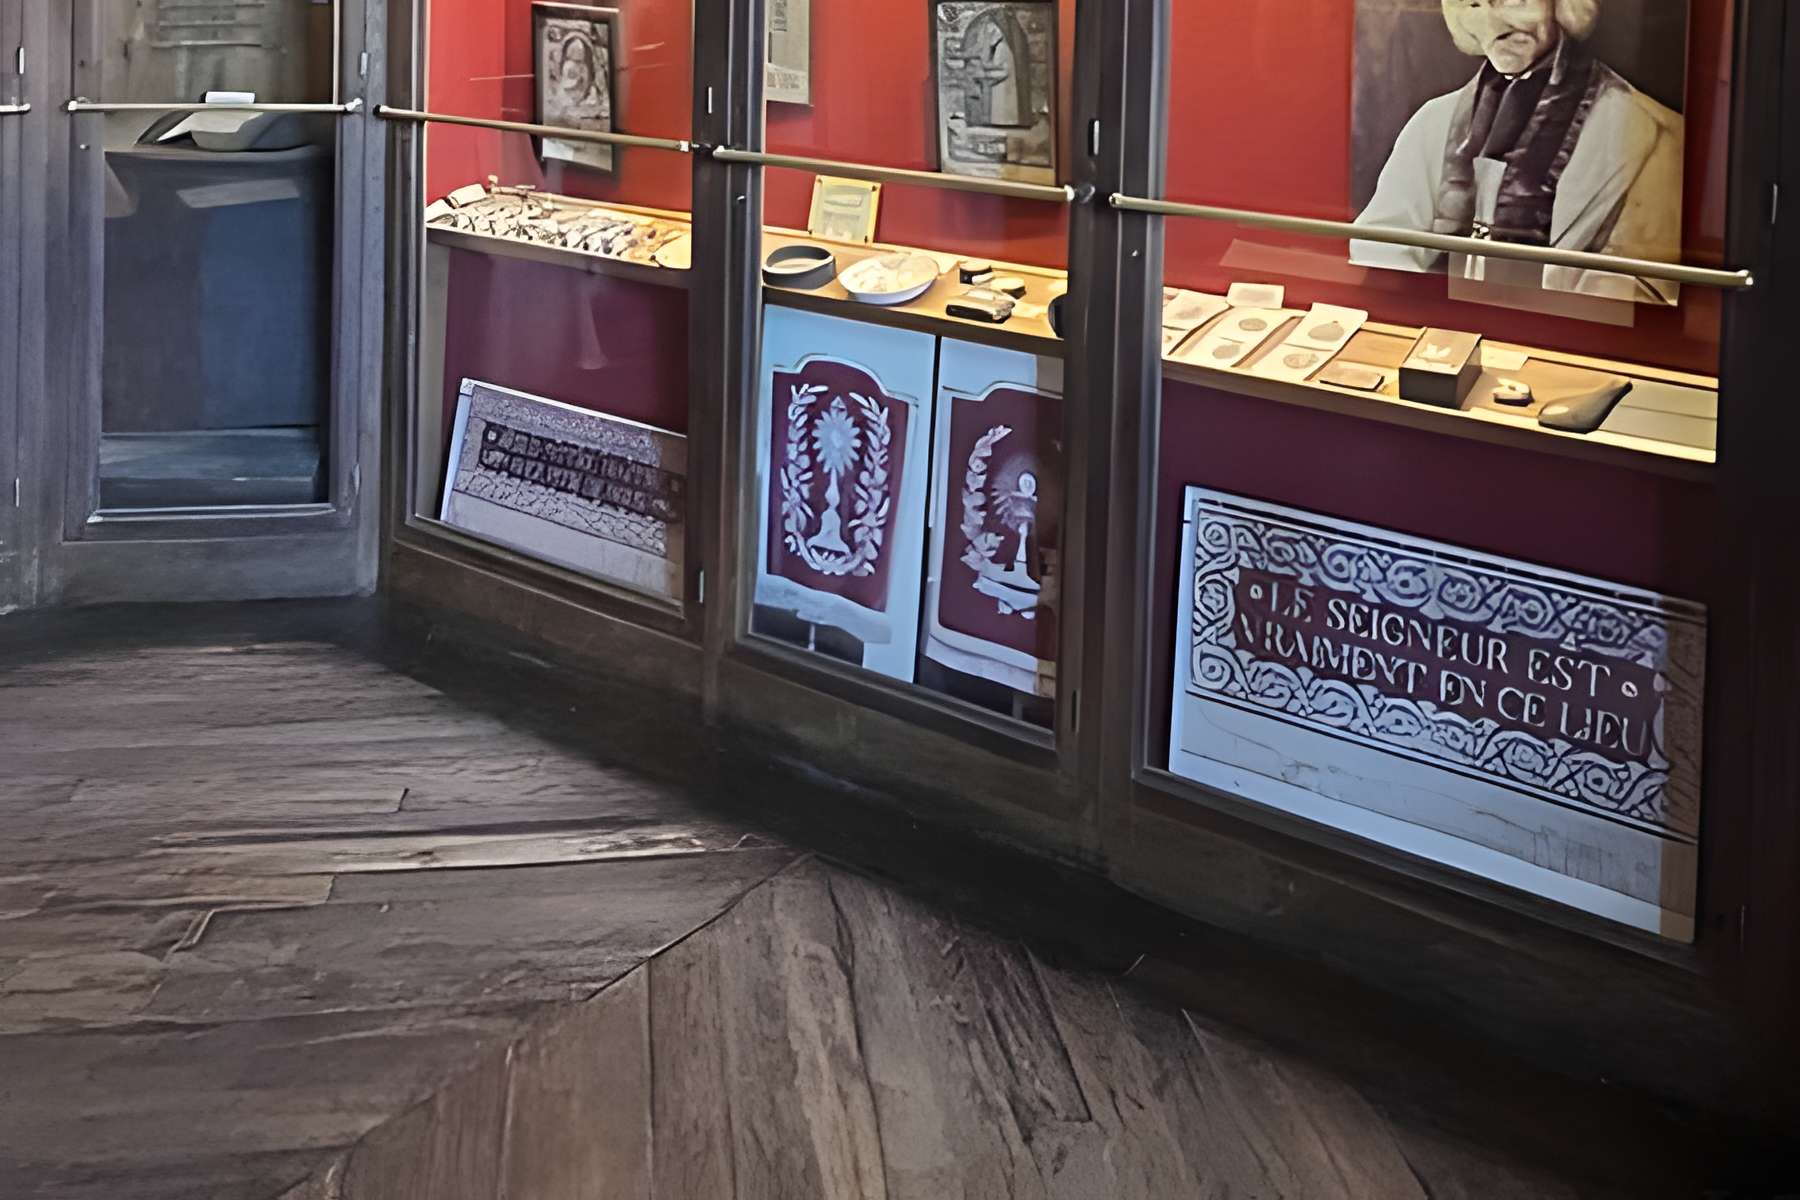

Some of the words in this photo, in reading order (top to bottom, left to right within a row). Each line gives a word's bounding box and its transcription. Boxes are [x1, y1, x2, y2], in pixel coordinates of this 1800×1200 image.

[1326, 598, 1509, 674] SEIGNEUR
[1528, 649, 1611, 697] EST
[1497, 686, 1546, 728] CE
[1560, 701, 1648, 756] LIEU
